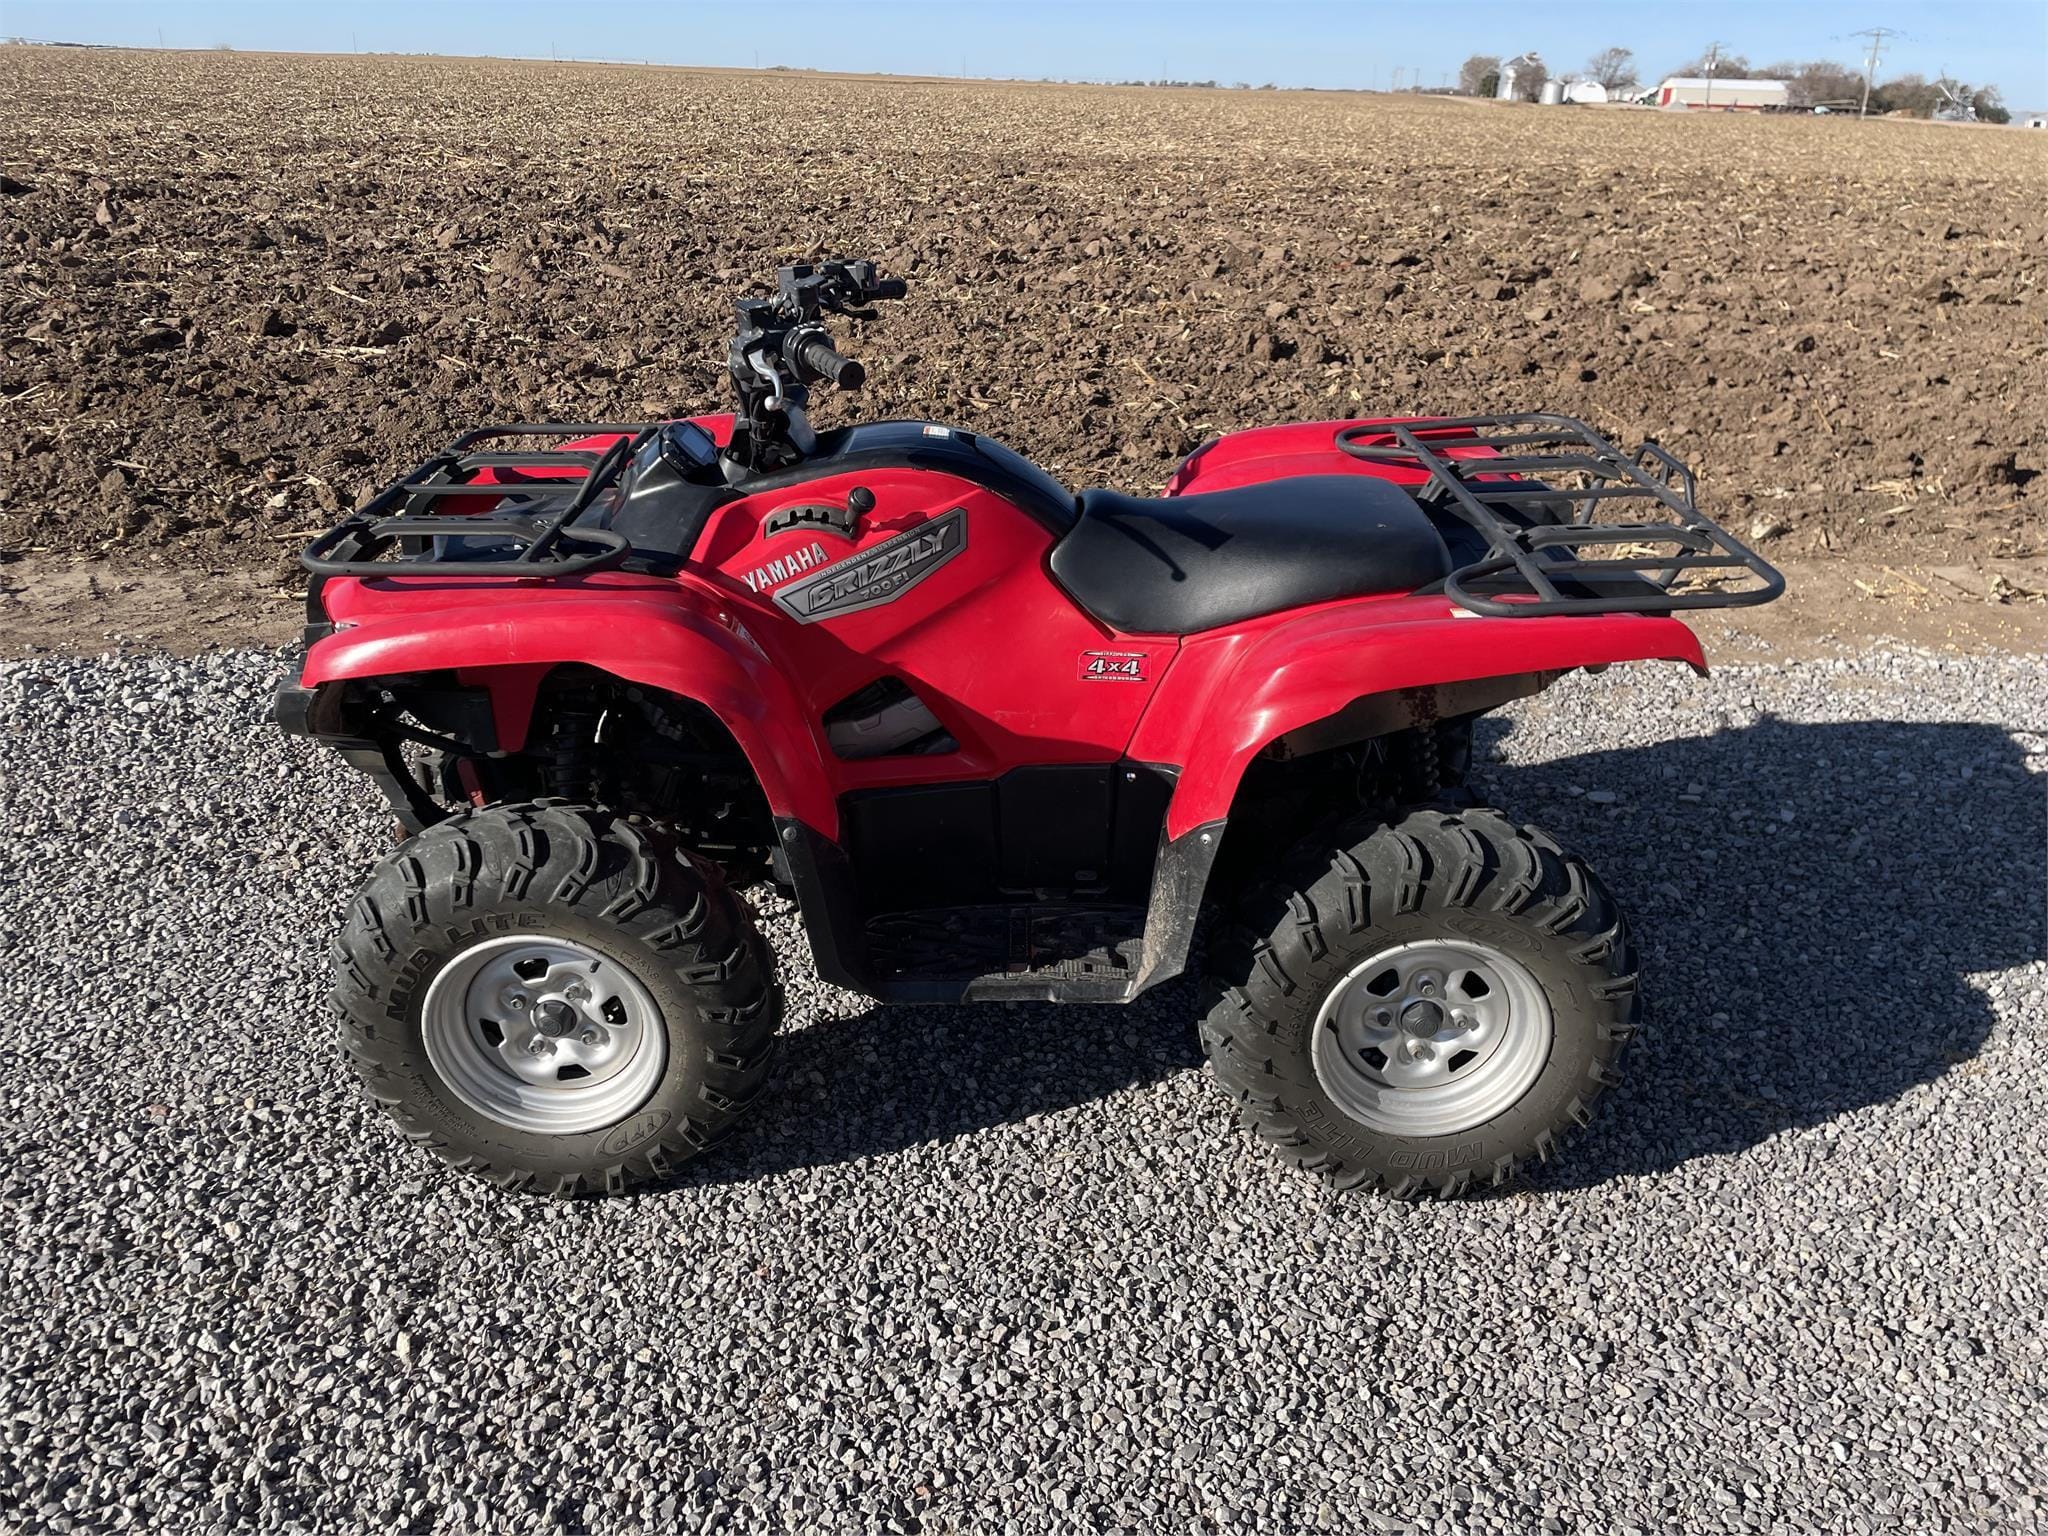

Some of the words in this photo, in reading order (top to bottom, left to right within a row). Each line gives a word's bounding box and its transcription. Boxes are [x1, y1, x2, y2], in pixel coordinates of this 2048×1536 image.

[741, 542, 830, 593] YAMAHA
[808, 524, 951, 613] GRIZZLY
[1087, 657, 1141, 676] 4x4
[385, 946, 435, 1023] MUD
[446, 912, 546, 944] LITE
[1296, 1099, 1375, 1160] LITE
[1389, 1141, 1484, 1169] MUD
